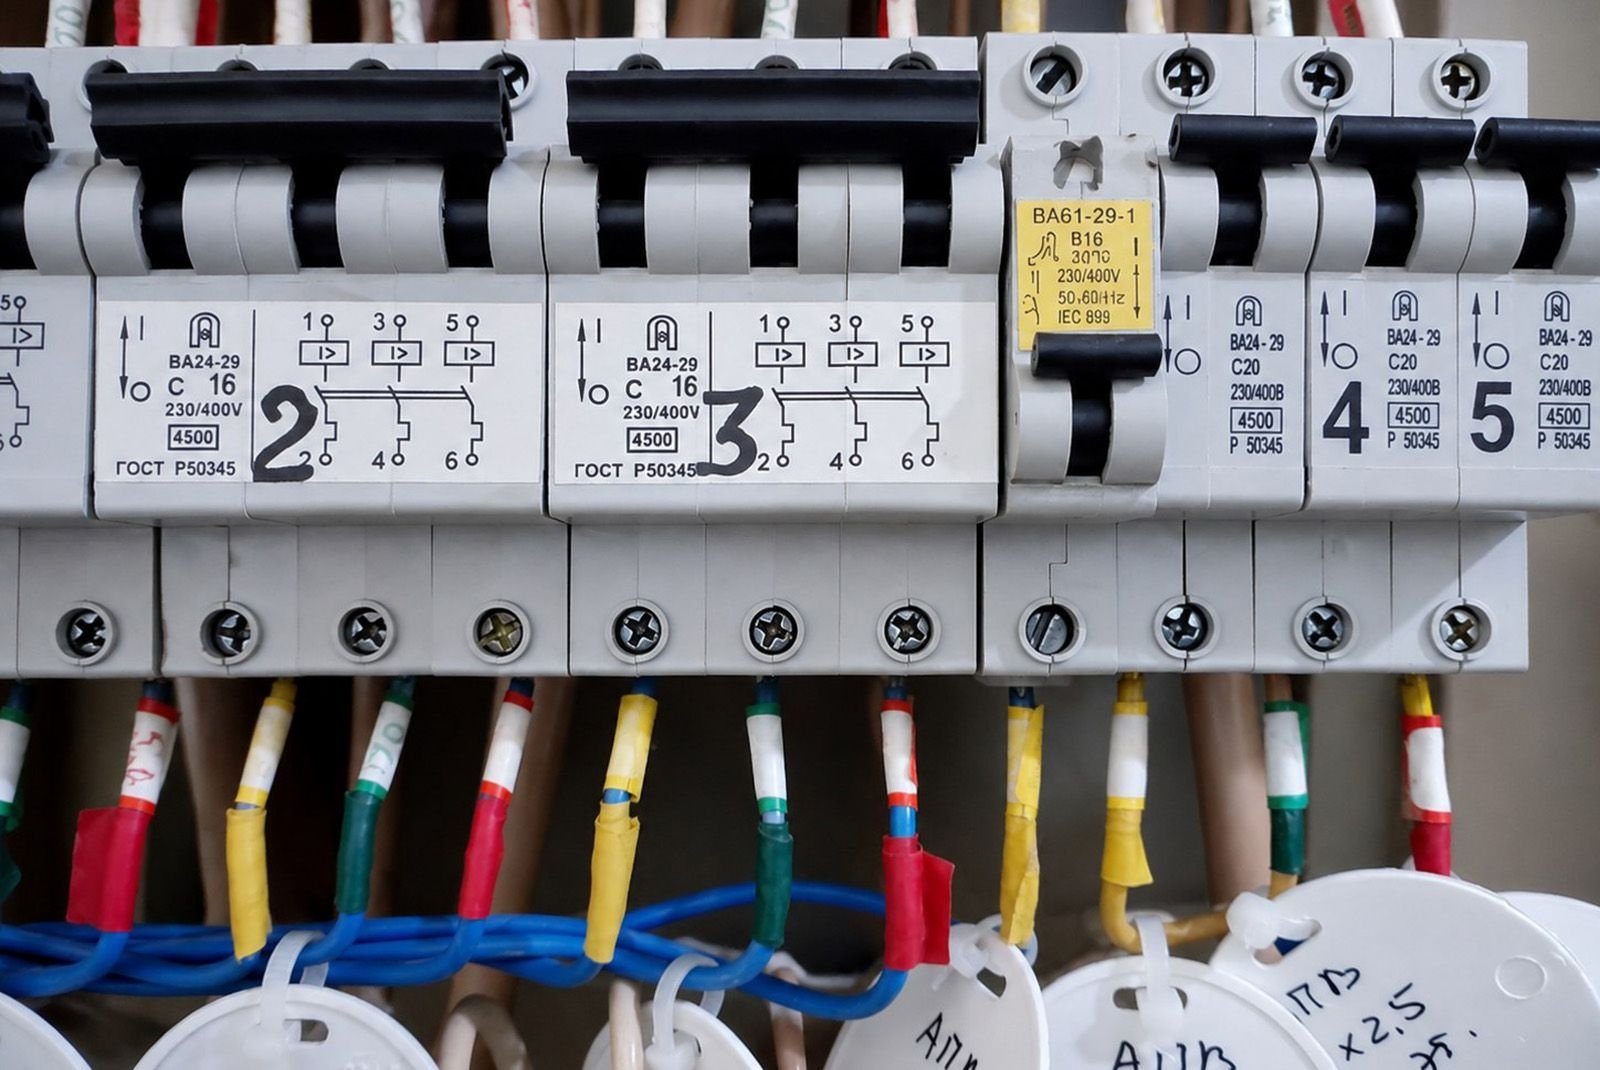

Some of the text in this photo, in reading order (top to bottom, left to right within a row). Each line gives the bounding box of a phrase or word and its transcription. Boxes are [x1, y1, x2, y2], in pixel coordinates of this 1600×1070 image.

[1072, 231, 1103, 246] B16
[1057, 269, 1120, 283] 230/400V
[373, 313, 385, 330] 3
[446, 314, 458, 332] 5
[829, 314, 840, 332] 3
[902, 314, 913, 332] 5
[1058, 310, 1110, 324] IEC 899
[1232, 358, 1260, 375] C20
[1388, 353, 1417, 370] C20
[1540, 353, 1568, 370] C20
[209, 373, 236, 395] 16
[673, 375, 697, 397] 16
[165, 403, 242, 417] 230/400V
[623, 405, 700, 419] 230/400V
[1322, 381, 1369, 454] 4
[1395, 407, 1430, 424] 4500
[1470, 382, 1515, 453] 5
[1546, 408, 1581, 424] 4500
[1238, 411, 1273, 430] 4500
[173, 430, 213, 445] 4500
[253, 384, 318, 482] 2
[696, 385, 764, 476] 3
[632, 433, 672, 447] 4500
[1247, 437, 1283, 454] 50345
[1404, 432, 1440, 449] 50345
[1554, 433, 1590, 449] 50345
[116, 461, 165, 475] ГОСТ
[372, 451, 384, 469] 4
[445, 452, 457, 470] 6
[758, 453, 913, 471] 2 4 6
[575, 464, 623, 477] ГОСТ
